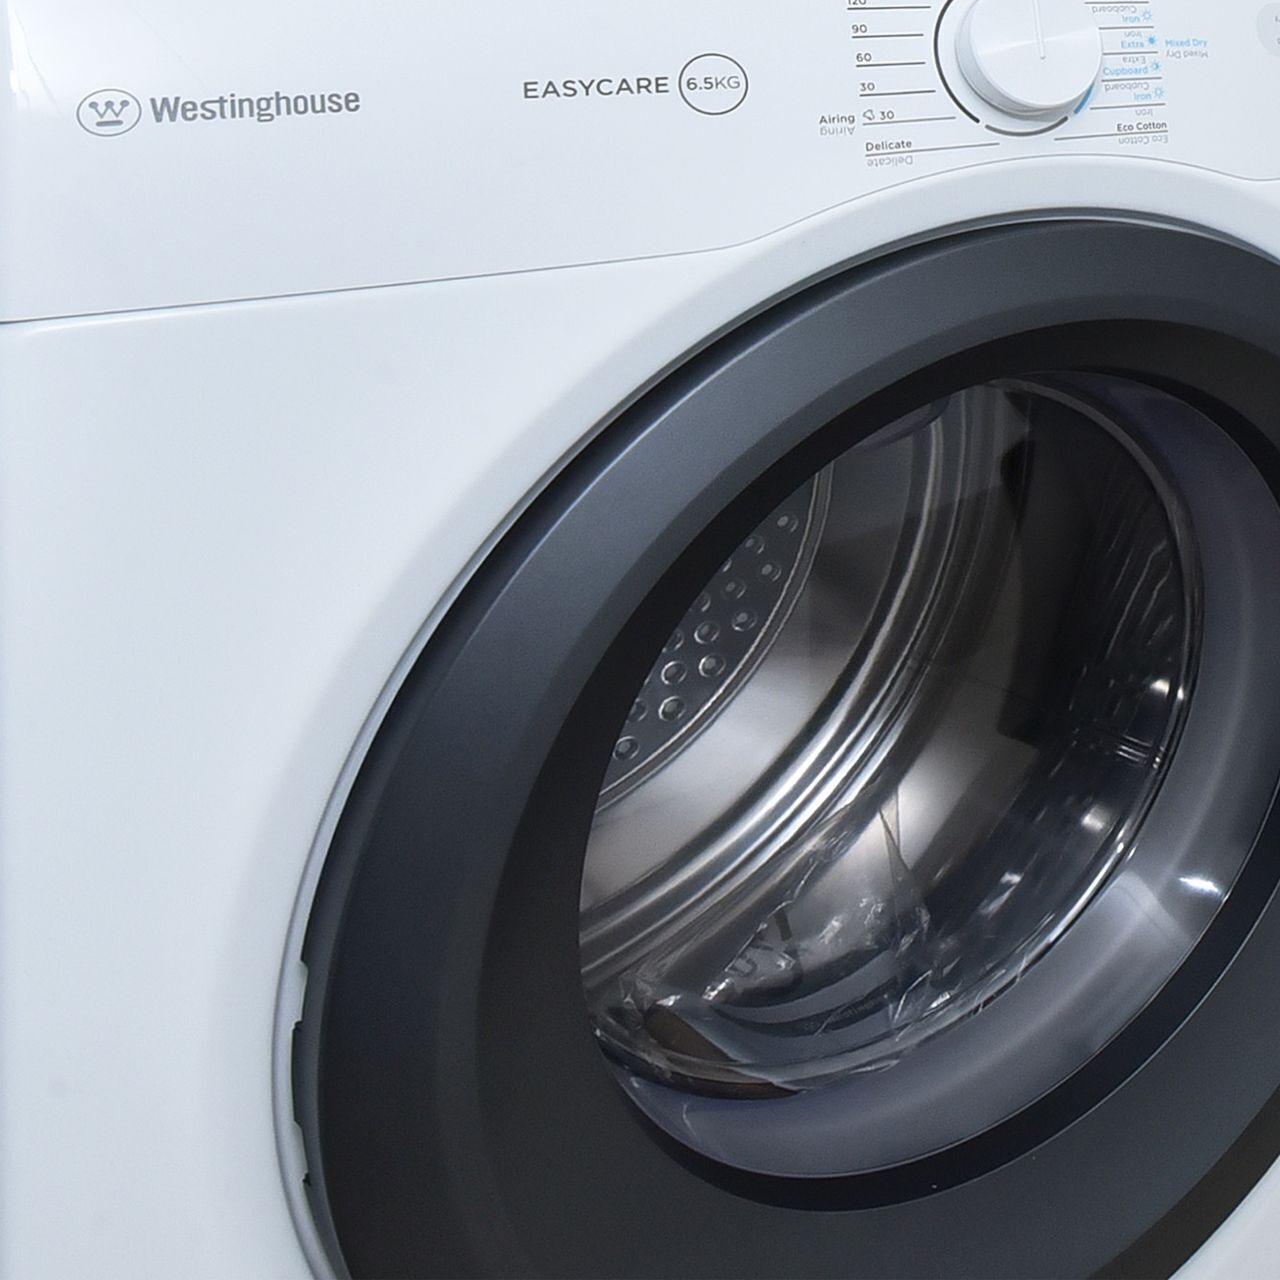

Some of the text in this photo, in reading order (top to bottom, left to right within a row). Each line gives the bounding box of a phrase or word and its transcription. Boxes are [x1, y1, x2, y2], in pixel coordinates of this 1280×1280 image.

[1122, 15, 1140, 23] Iron
[852, 25, 867, 34] 90
[1120, 41, 1145, 49] Extra
[1165, 39, 1208, 48] Mixed Dry
[856, 53, 872, 62] 60
[1166, 50, 1181, 59] Dry
[1103, 66, 1149, 76] Cupboard
[522, 76, 670, 99] EASYCARE
[686, 74, 741, 92] 6.5KG
[860, 82, 875, 91] 30
[150, 91, 361, 123] Westinghouse
[819, 115, 855, 126] Airing
[879, 111, 895, 120] 30
[819, 126, 855, 136] Airing
[1116, 122, 1167, 132] Eco Cotton
[1118, 134, 1169, 145] Eco Cotton
[865, 139, 912, 152] Delicate
[867, 156, 913, 167] Delicate
